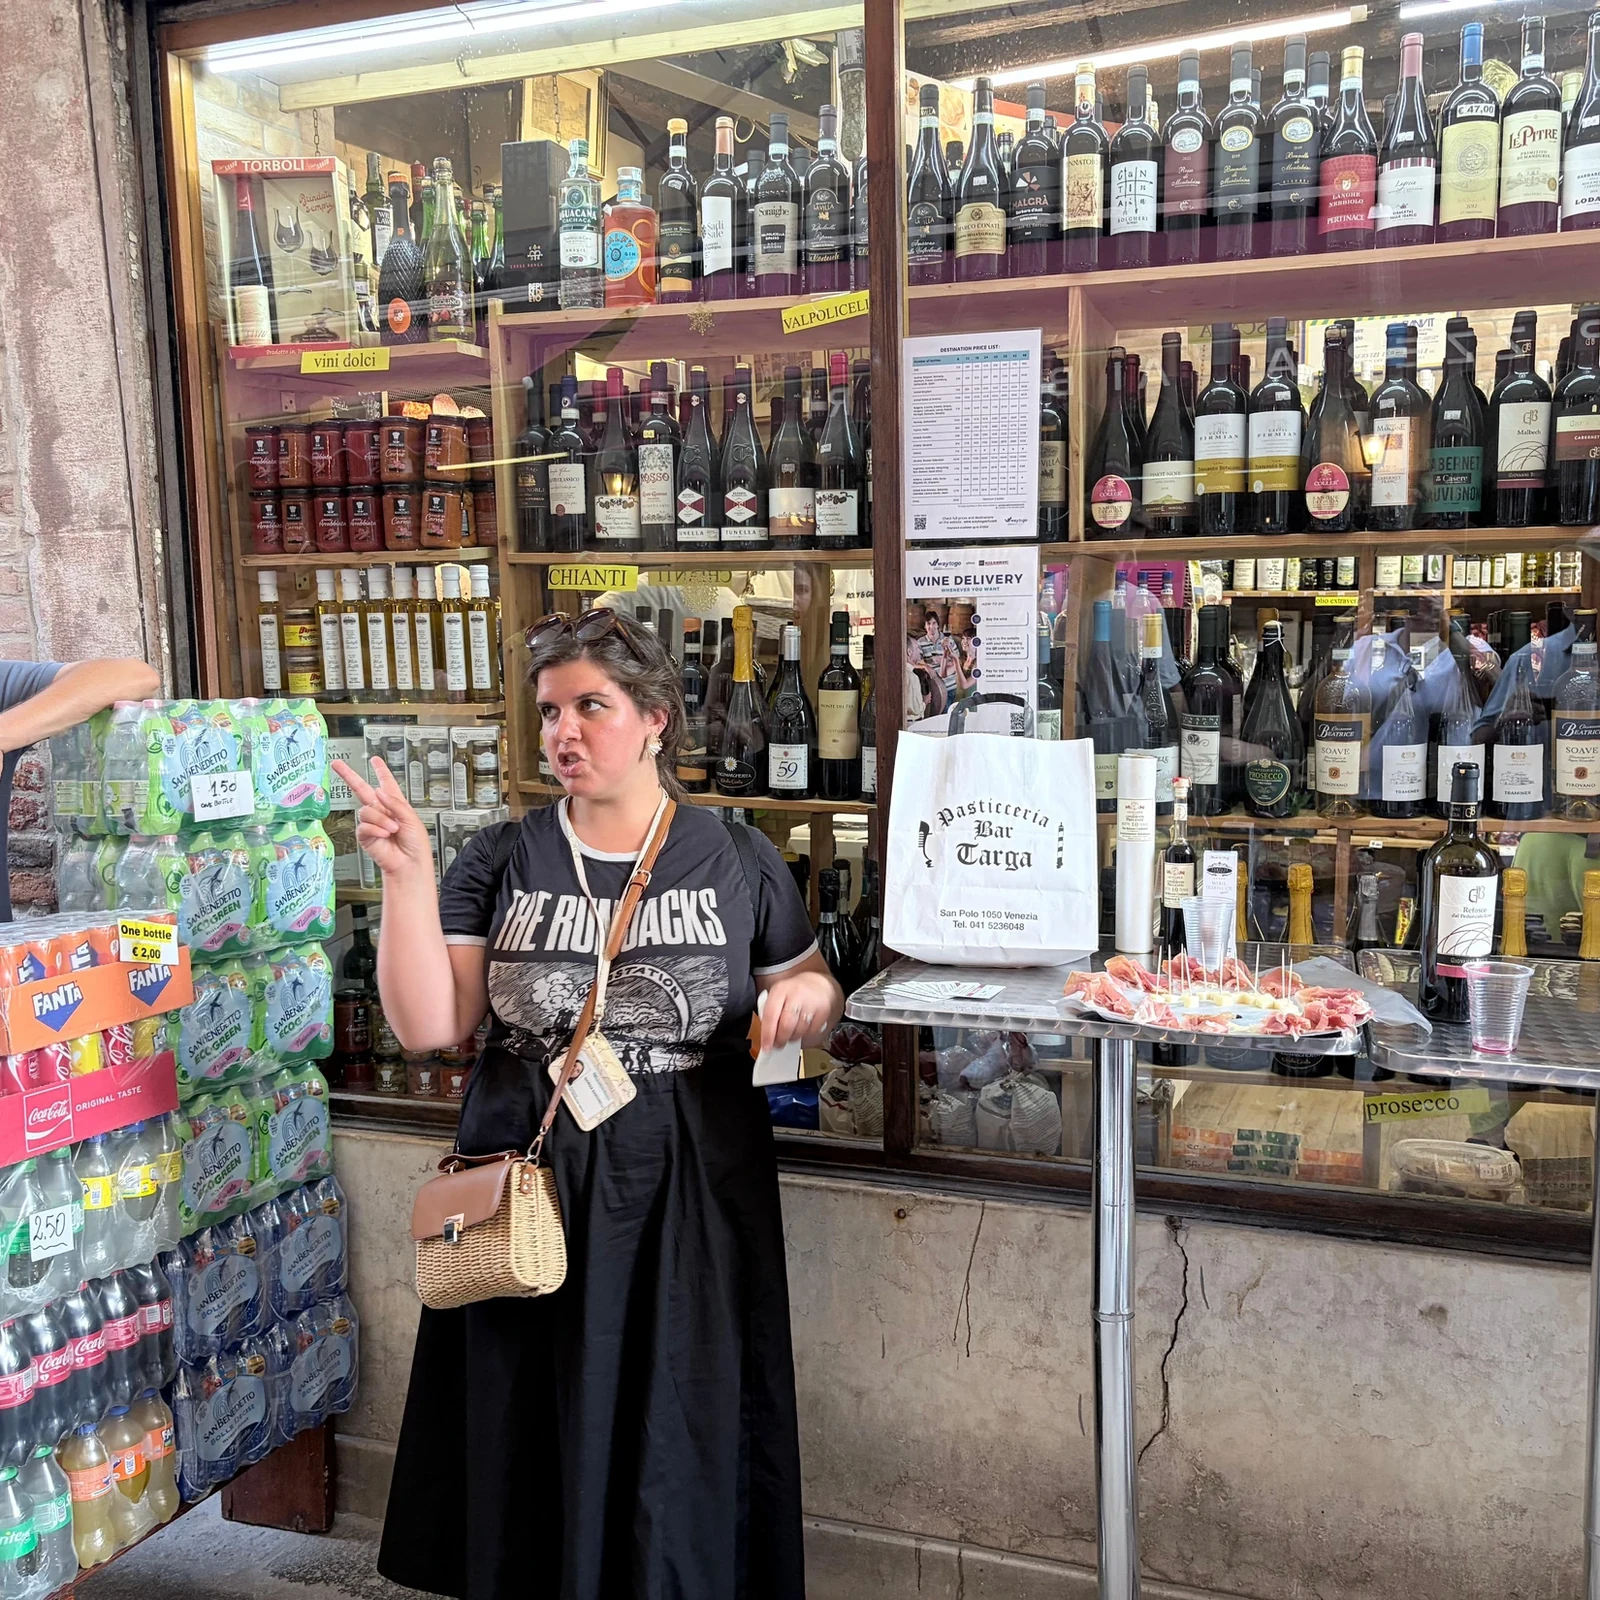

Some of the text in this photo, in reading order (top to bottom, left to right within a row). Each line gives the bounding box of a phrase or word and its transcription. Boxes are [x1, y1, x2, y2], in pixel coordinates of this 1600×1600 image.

[1520, 125, 1558, 147] PITRE
[242, 159, 305, 172] TORBOLI
[758, 204, 789, 217] Soraighe
[1327, 214, 1365, 224] PERTINACE
[314, 352, 376, 368] vini dolci
[549, 568, 627, 588] CHIANTI
[913, 574, 1024, 587] WINE DELIVERY
[1321, 746, 1350, 756] SOAVE
[1565, 746, 1599, 755] SOAVE
[776, 761, 798, 777] 59
[1249, 772, 1283, 780] PROSECCO
[937, 798, 1050, 828] Pasticceria
[974, 820, 1014, 840] Bar
[956, 842, 1033, 872] Targa
[494, 889, 553, 951] THE
[940, 909, 1038, 920] San Polo 1050 Venezia
[121, 924, 172, 940] One bottle
[953, 920, 1025, 931] Tel. 041 5236048
[132, 947, 161, 959] € 2,00
[129, 964, 172, 992] FANTA
[32, 982, 83, 1017] FANTA
[75, 1086, 142, 1112] ORIGINAL TASTE
[1366, 1094, 1460, 1120] prosecco
[33, 1212, 66, 1242] 2.50
